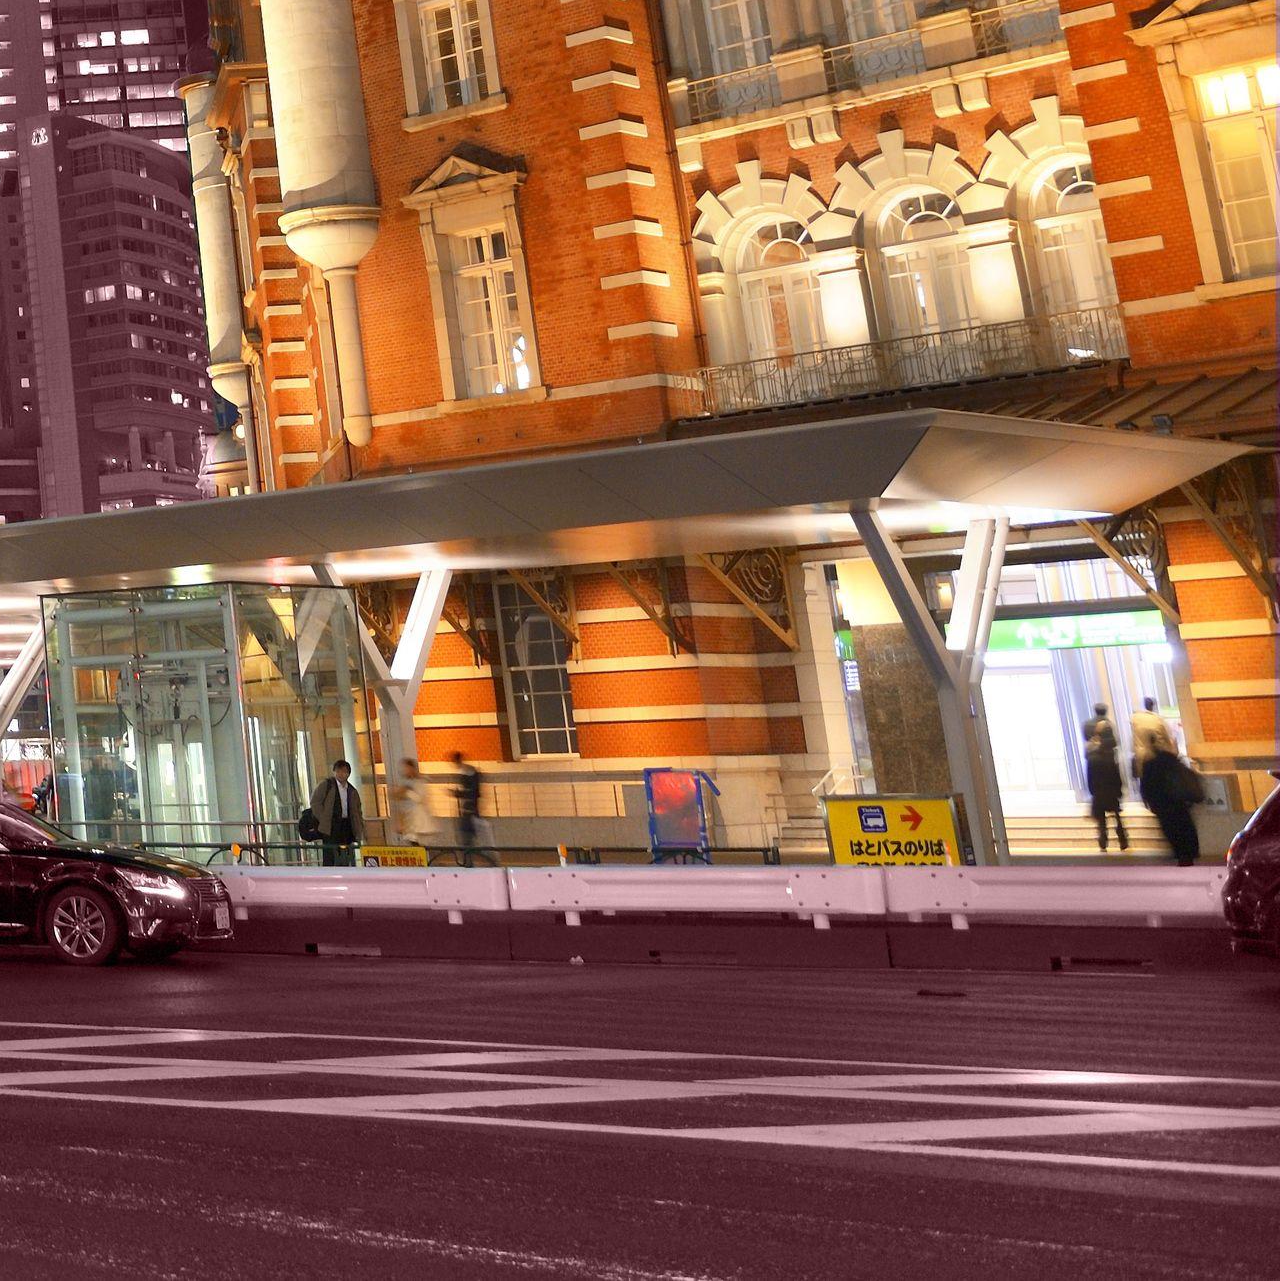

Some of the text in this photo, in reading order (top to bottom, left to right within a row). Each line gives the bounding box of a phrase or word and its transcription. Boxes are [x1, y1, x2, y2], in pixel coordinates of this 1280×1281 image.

[849, 839, 945, 856] はとバスのりば
